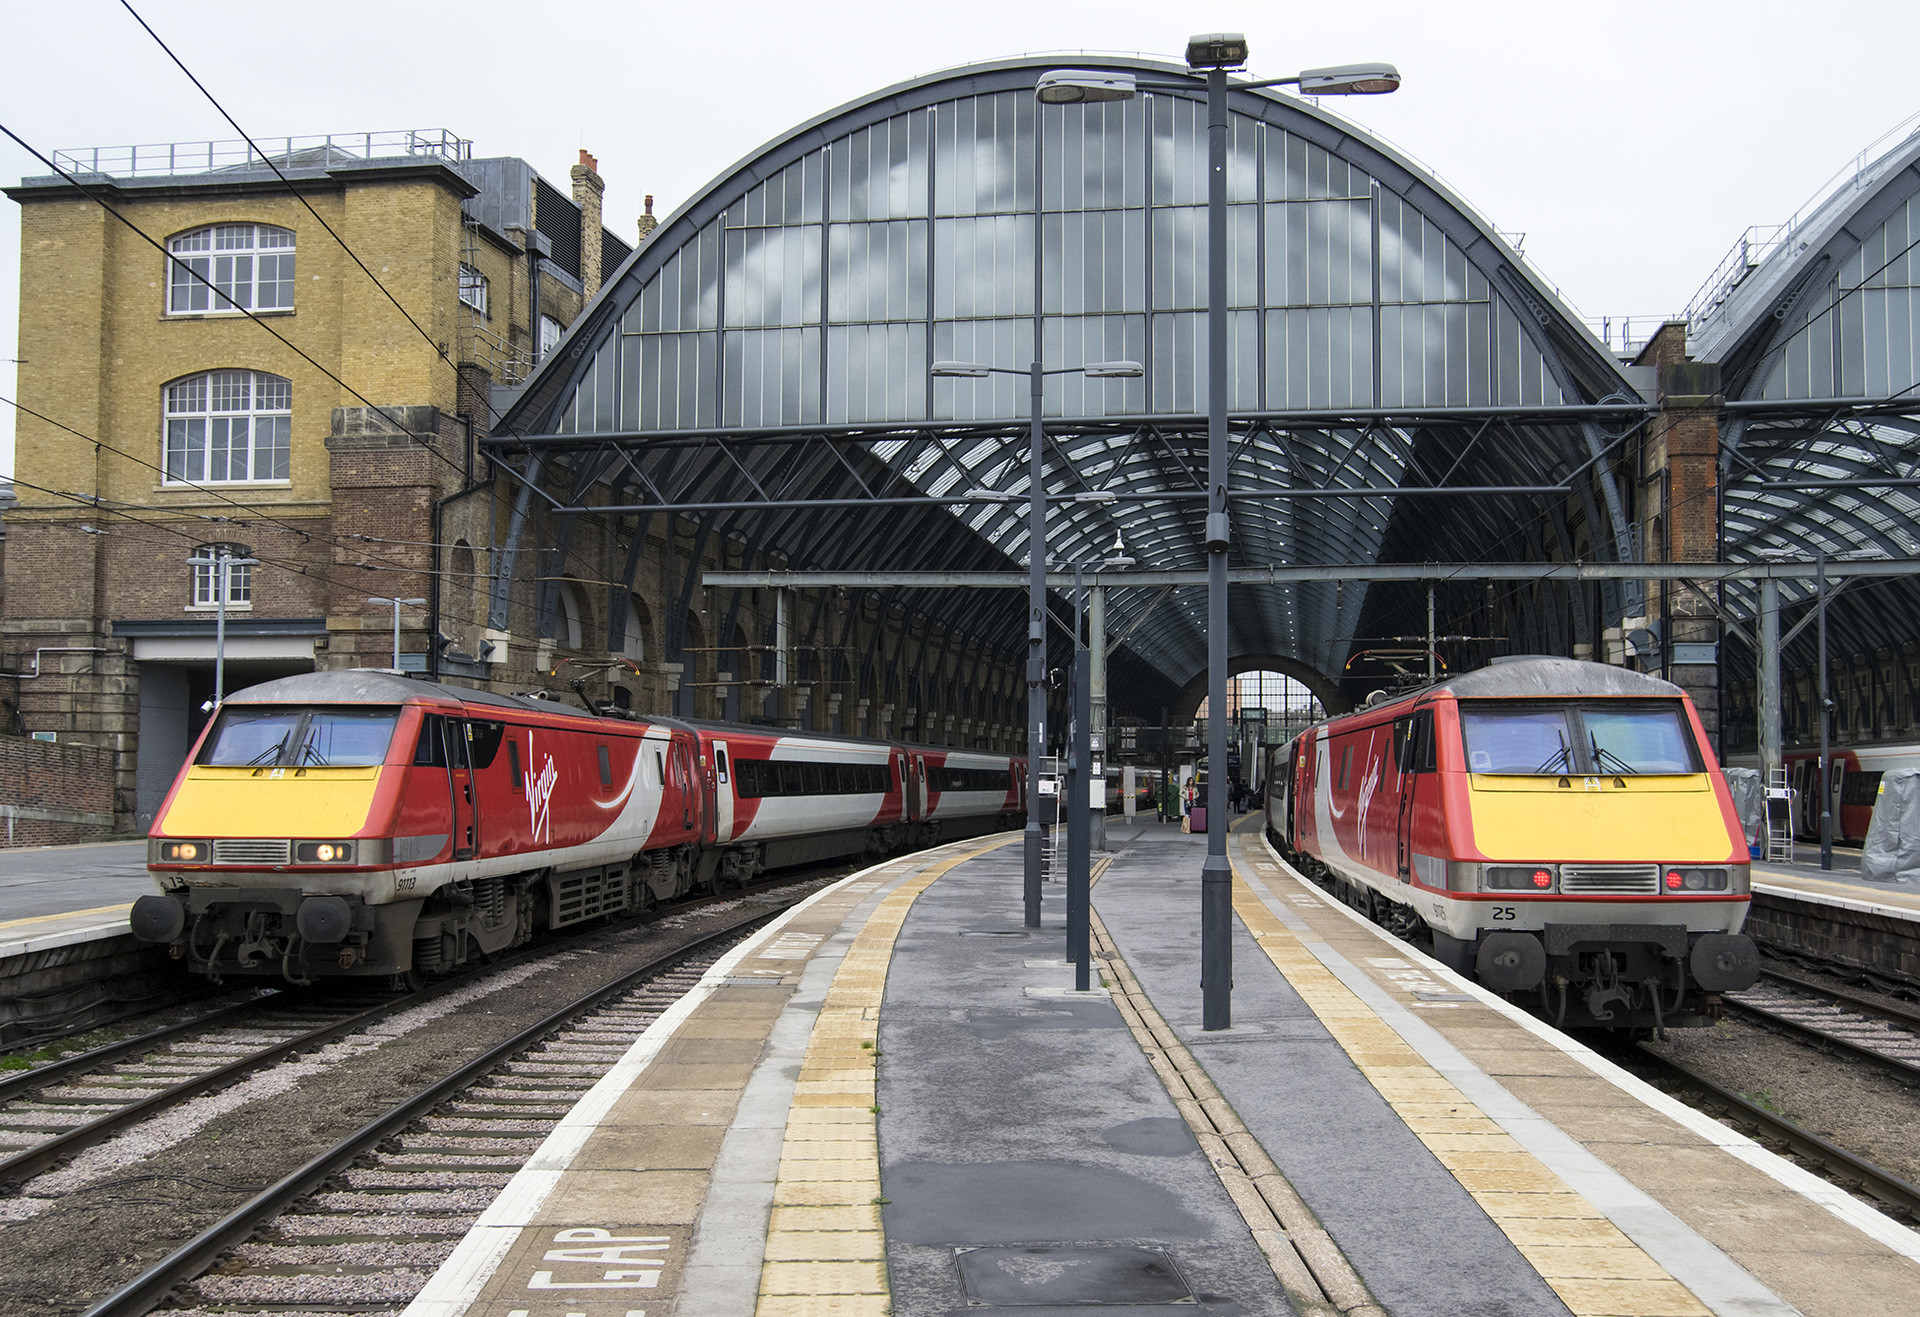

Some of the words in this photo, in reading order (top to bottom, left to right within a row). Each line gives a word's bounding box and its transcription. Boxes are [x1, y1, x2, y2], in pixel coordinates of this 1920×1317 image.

[525, 729, 558, 845] Virgin
[397, 877, 417, 891] 91113
[1492, 906, 1516, 920] 25
[526, 1228, 671, 1289] GAP
